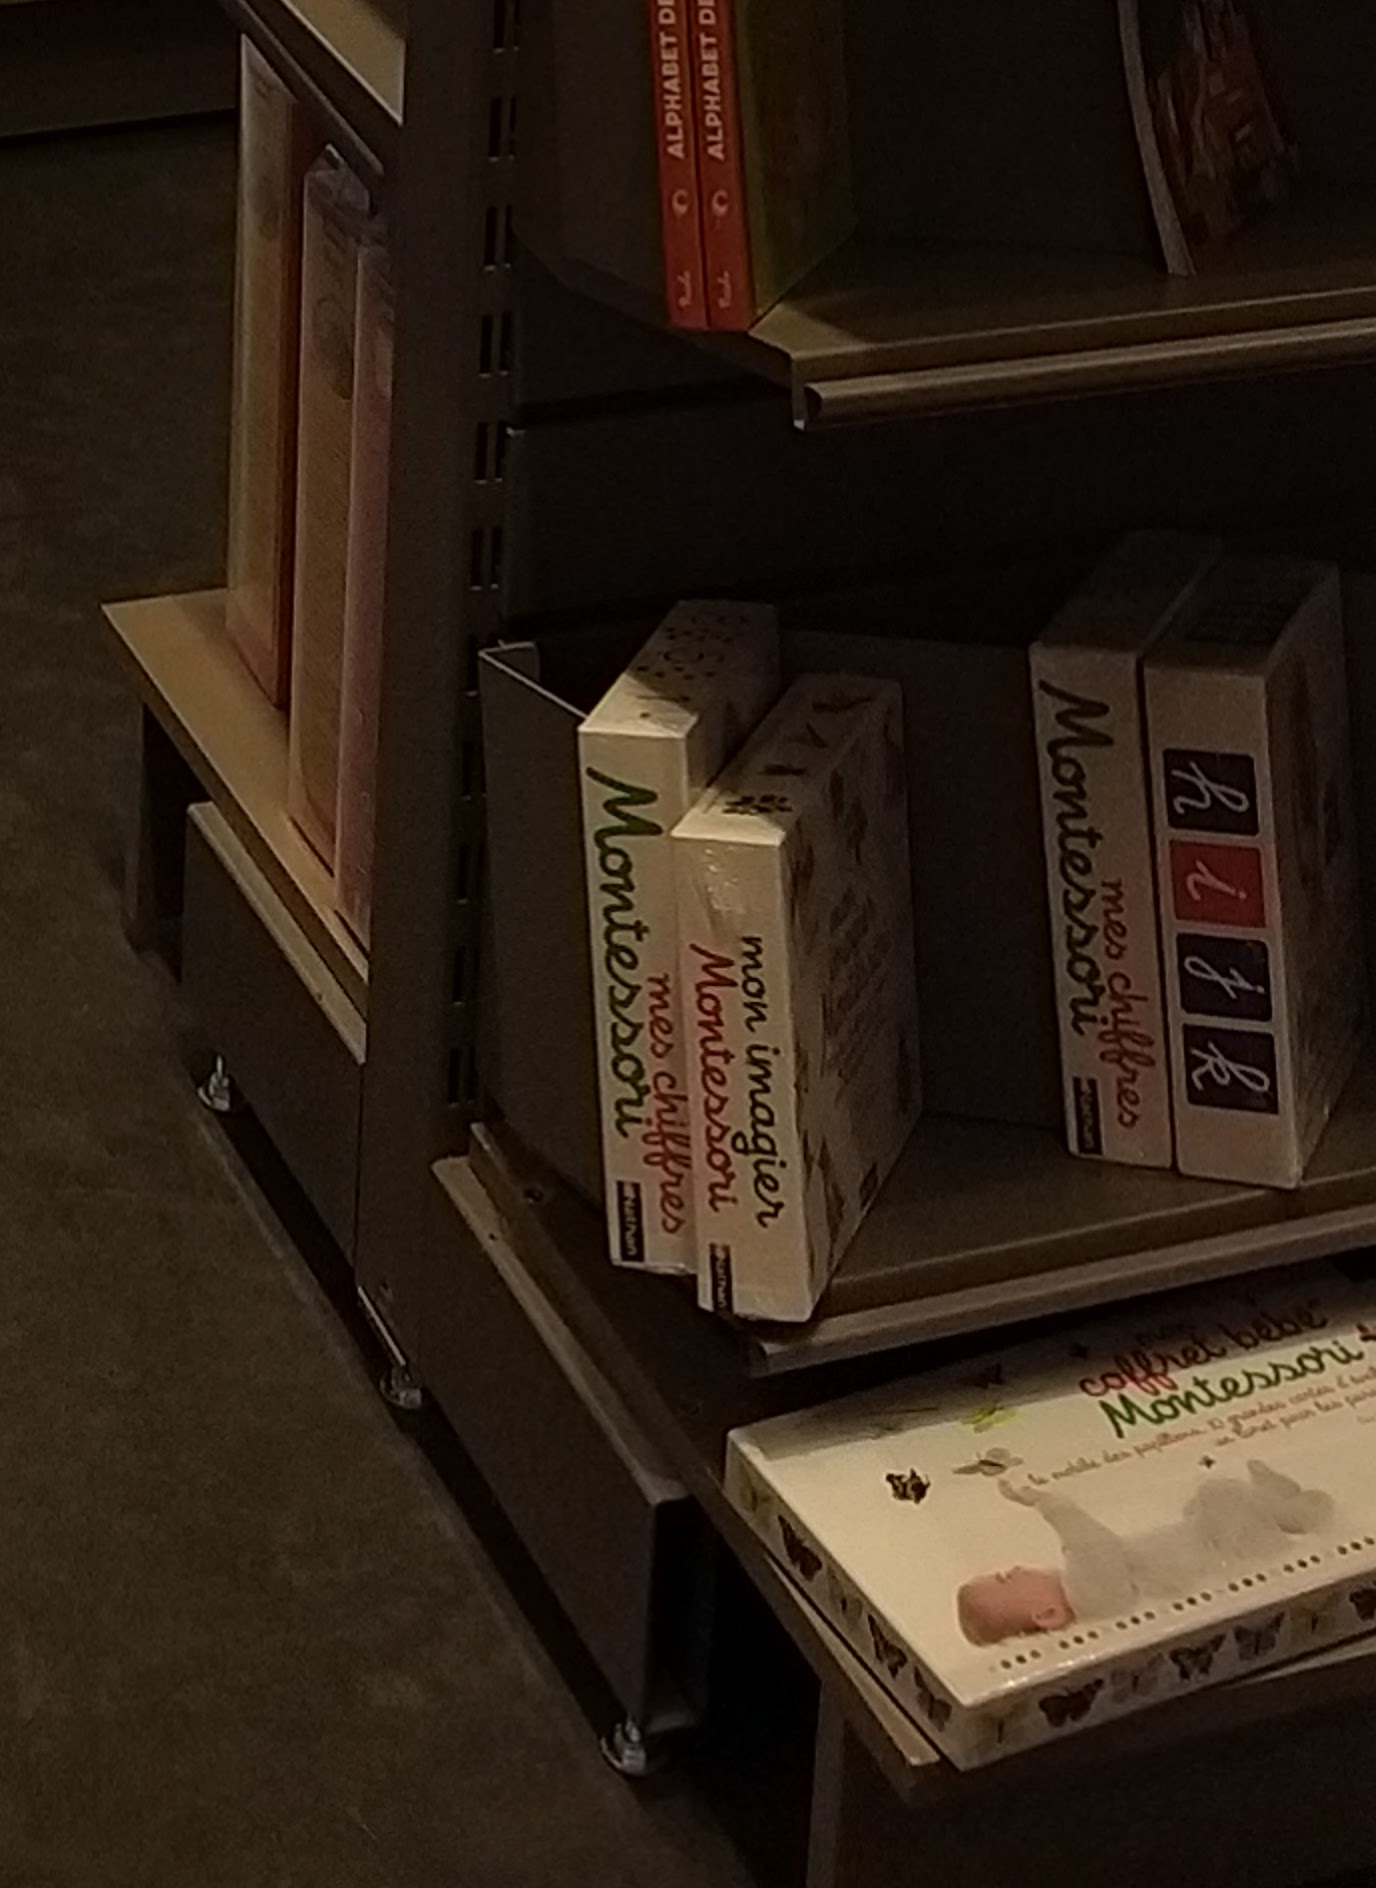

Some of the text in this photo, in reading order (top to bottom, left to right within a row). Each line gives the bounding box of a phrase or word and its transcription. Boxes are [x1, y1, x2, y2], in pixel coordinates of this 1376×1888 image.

[659, 33, 687, 160] ALPHABET
[698, 32, 726, 161] ALPHABET
[586, 765, 664, 1139] Montessori
[1038, 679, 1114, 1037] Montessori
[642, 972, 693, 1235] mes chiffres
[690, 942, 739, 1214] Montessori
[732, 934, 784, 1228] mon imagier
[1098, 877, 1156, 1130] mes chiffres
[1079, 1332, 1227, 1397] coffret
[1098, 1339, 1364, 1439] Montessori
